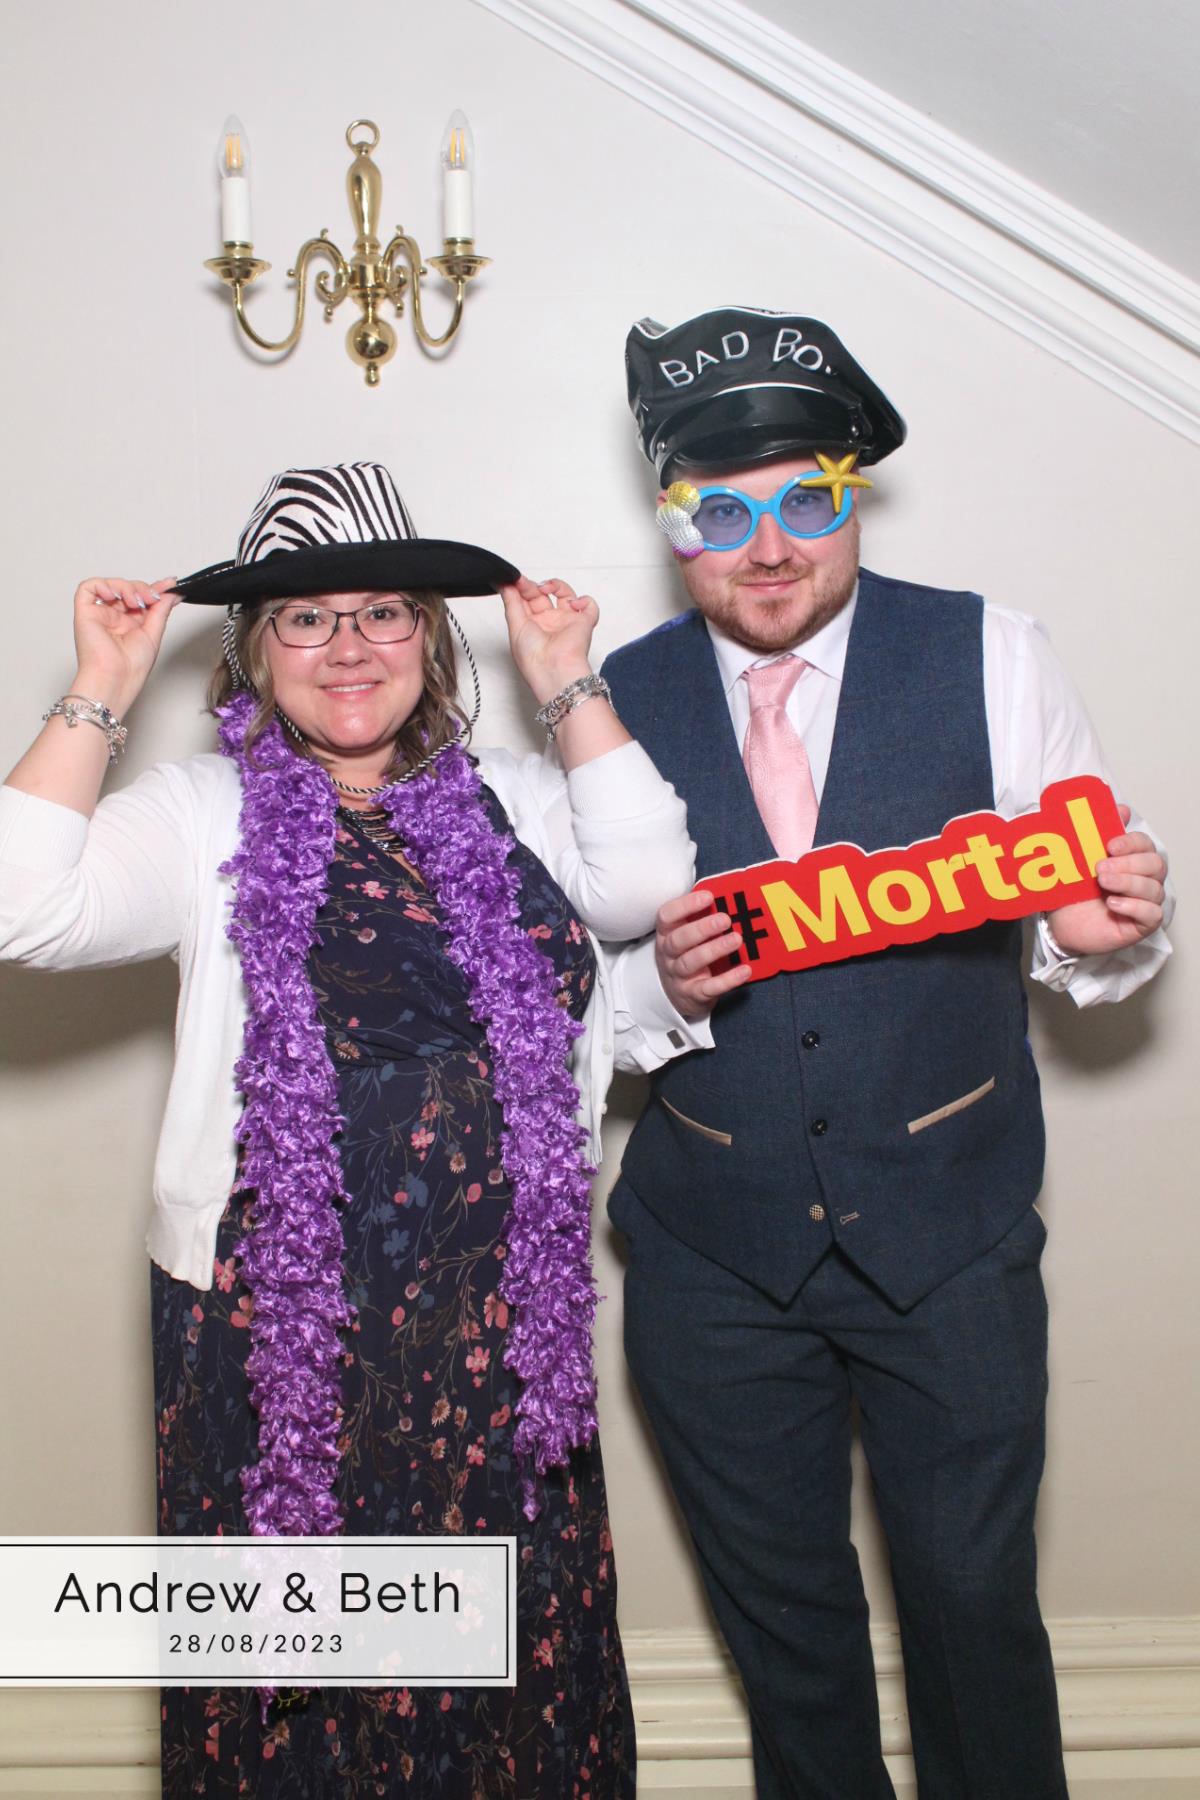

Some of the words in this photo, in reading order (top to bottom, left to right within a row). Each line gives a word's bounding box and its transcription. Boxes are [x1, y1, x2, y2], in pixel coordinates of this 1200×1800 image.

[659, 331, 749, 388] BAD
[772, 327, 832, 374] BO
[714, 796, 1108, 965] #Mortal
